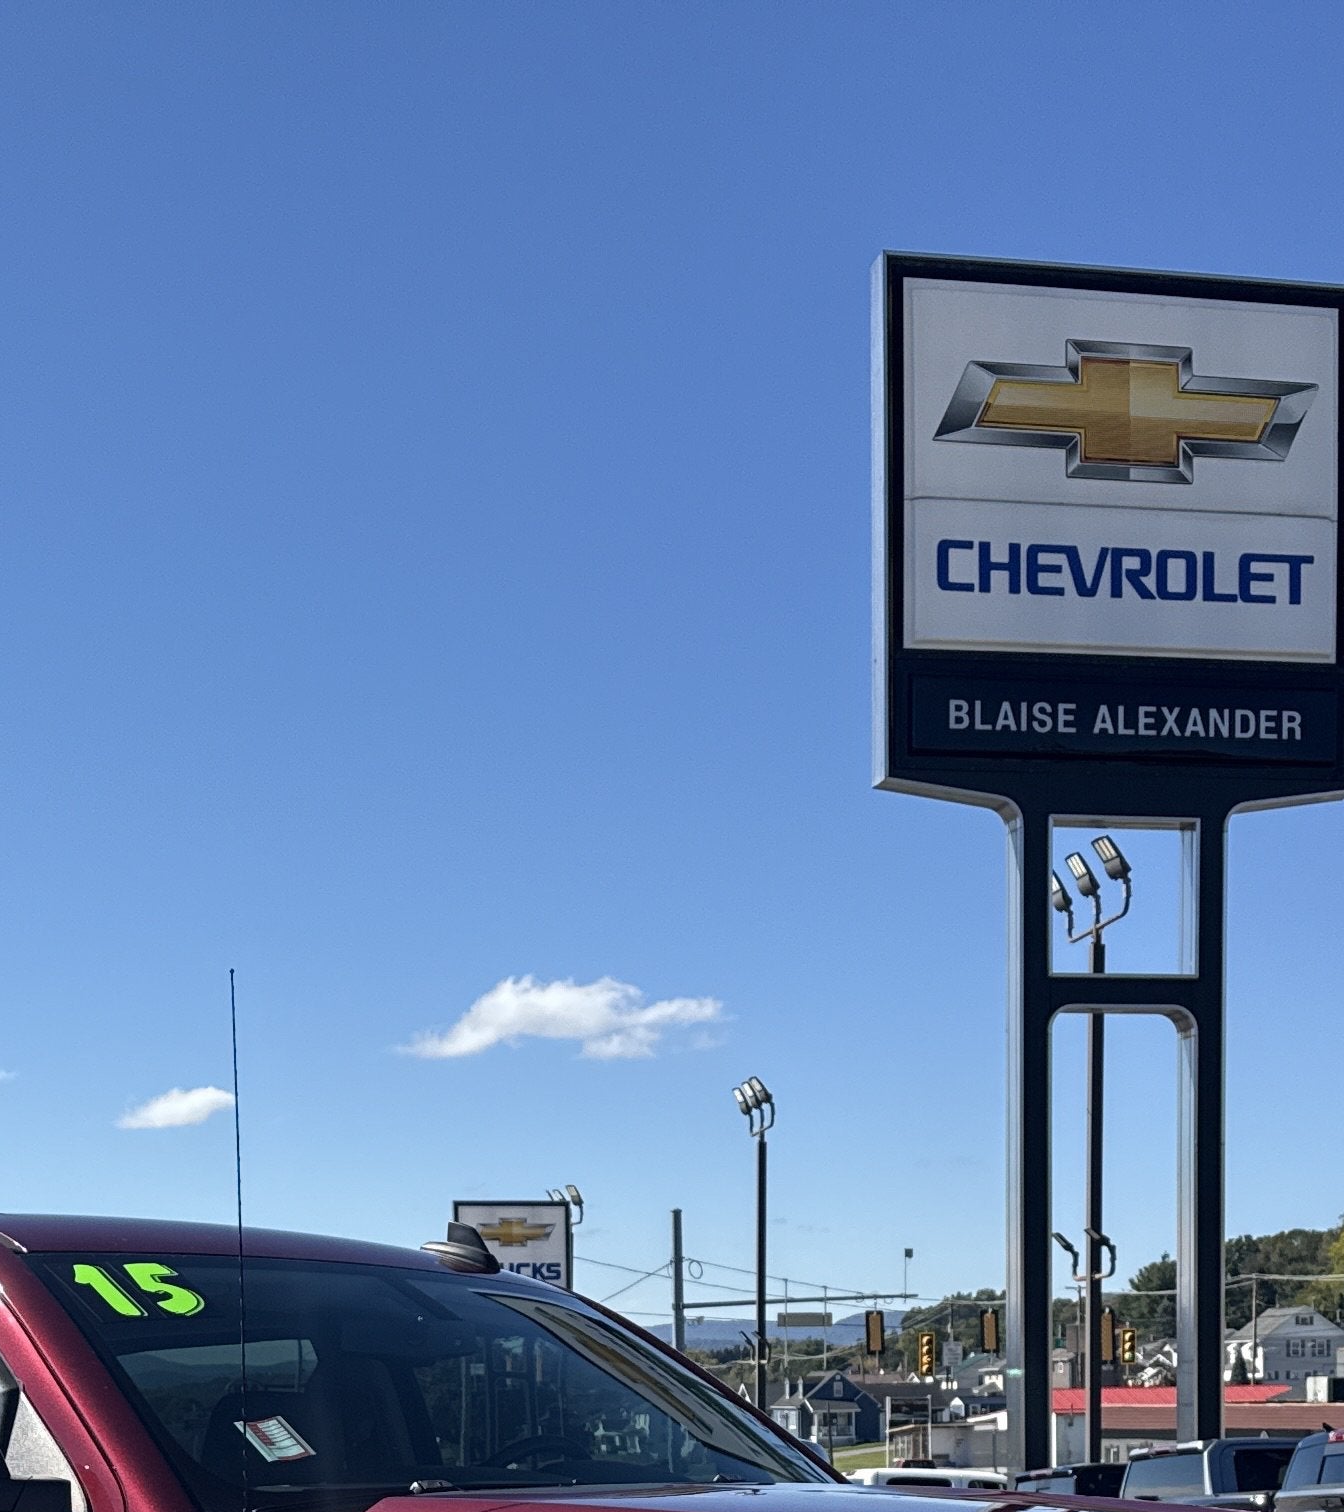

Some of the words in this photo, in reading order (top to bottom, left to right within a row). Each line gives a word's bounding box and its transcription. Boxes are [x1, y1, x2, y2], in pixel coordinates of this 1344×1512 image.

[936, 538, 1314, 605] CHEVROLET
[948, 699, 1077, 734] BLAISE
[1092, 704, 1302, 741] ALEXANDER
[73, 1263, 205, 1317] 15
